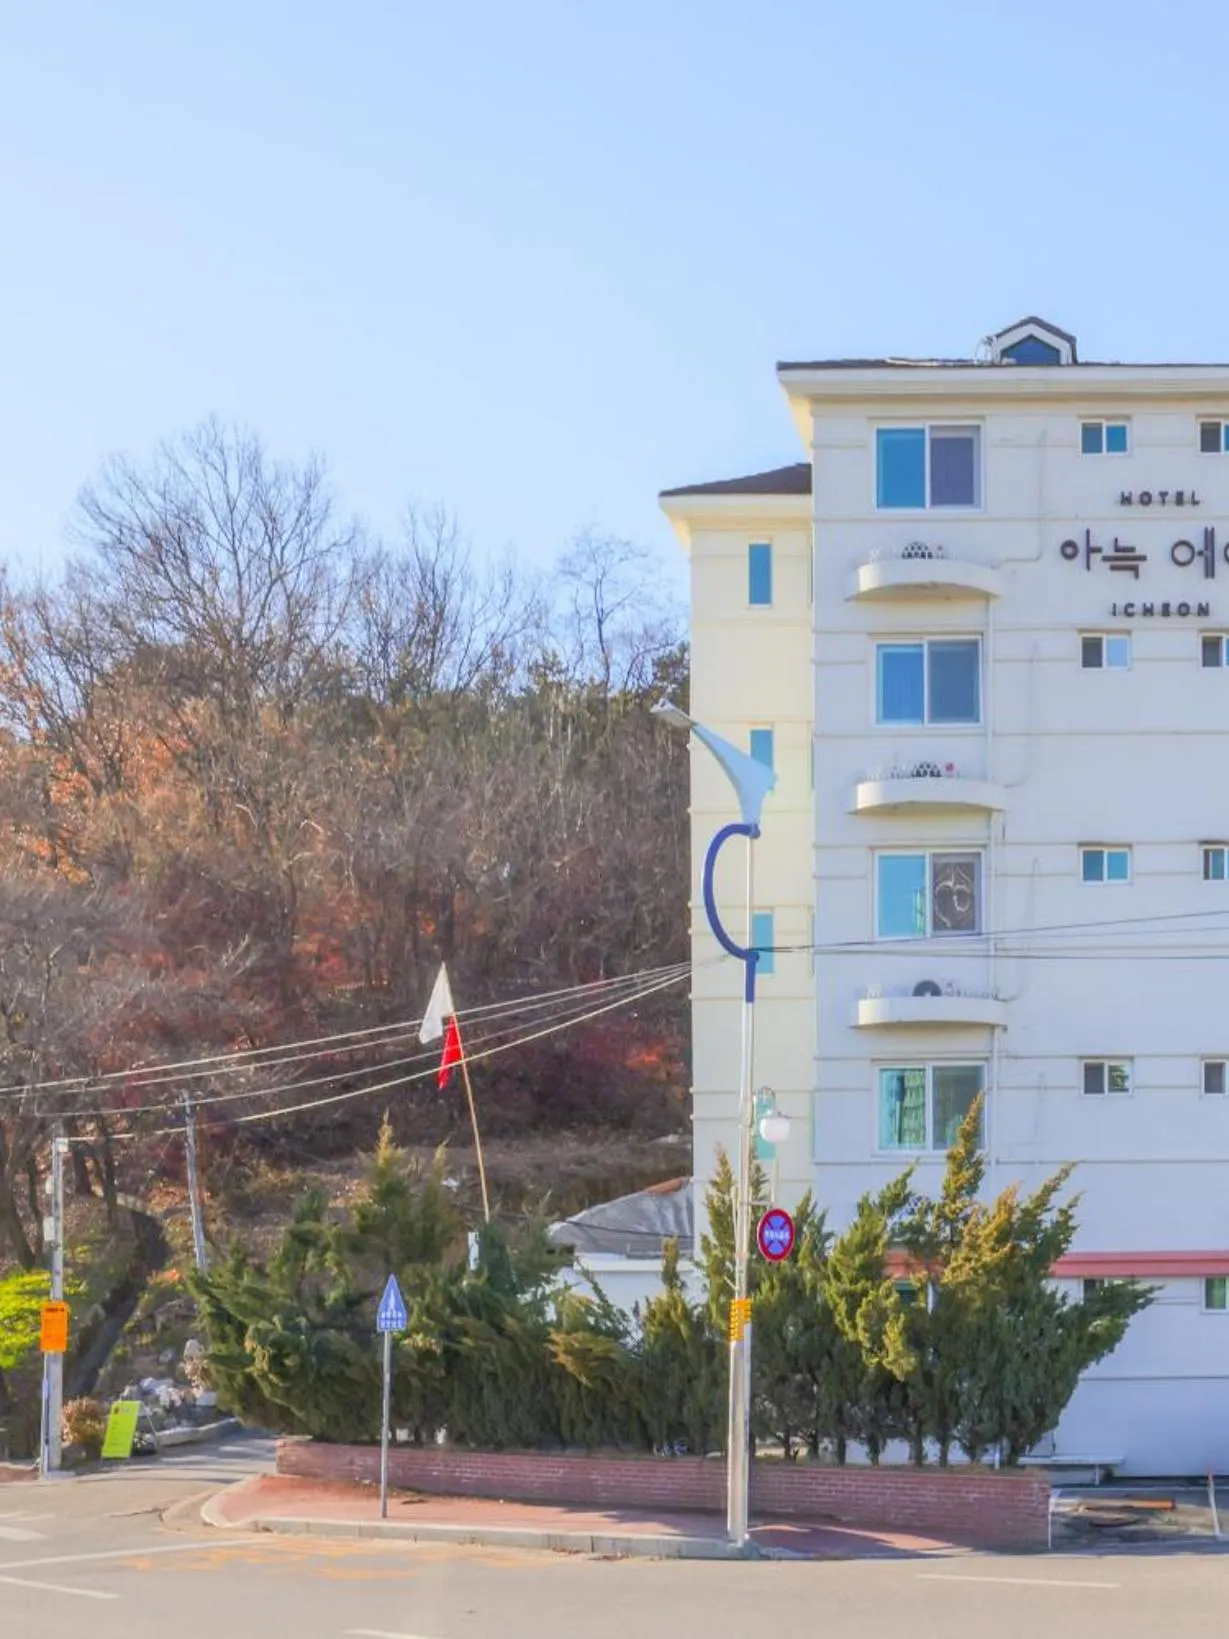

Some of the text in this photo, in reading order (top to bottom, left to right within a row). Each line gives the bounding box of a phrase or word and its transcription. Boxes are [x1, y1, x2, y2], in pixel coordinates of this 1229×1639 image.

[1119, 491, 1201, 506] HOTEL
[1060, 527, 1148, 580] 아늑
[1111, 602, 1210, 617] ICHEON
